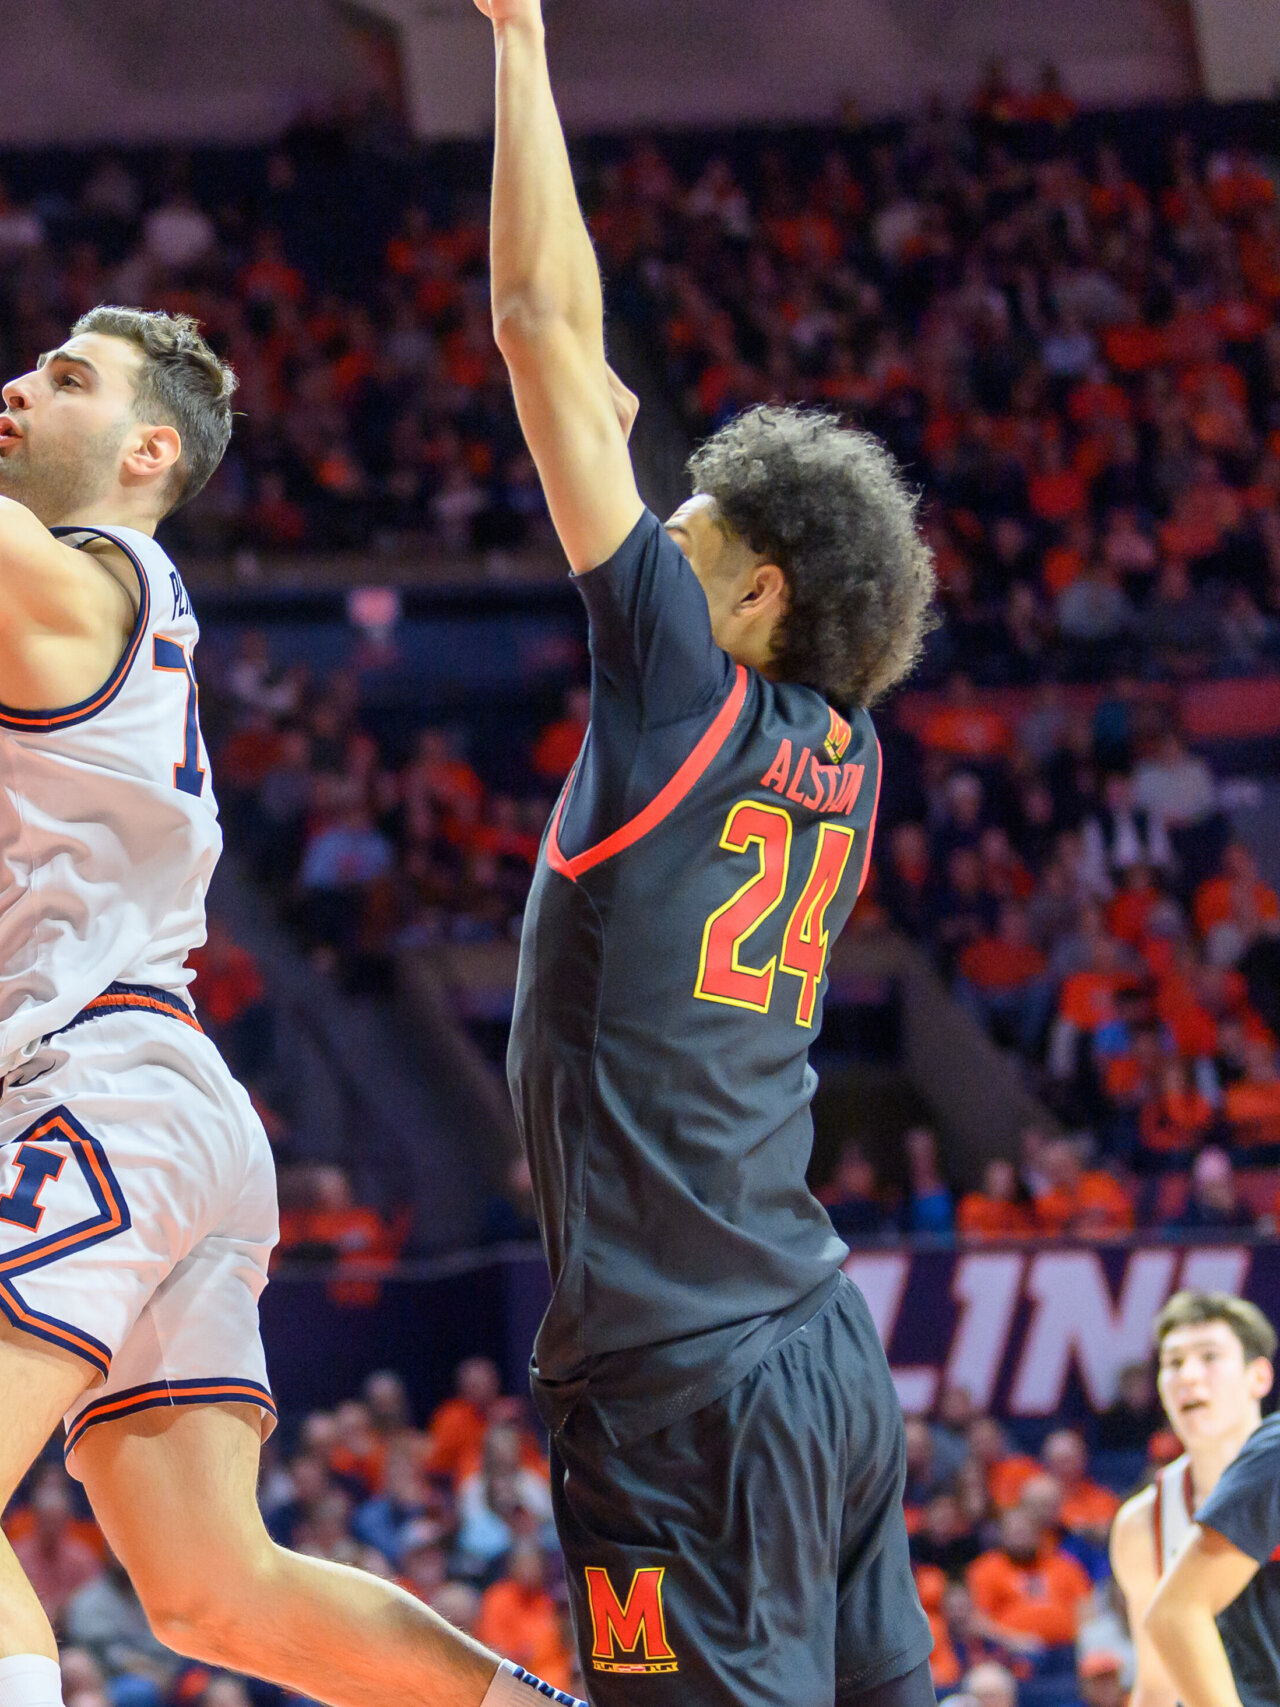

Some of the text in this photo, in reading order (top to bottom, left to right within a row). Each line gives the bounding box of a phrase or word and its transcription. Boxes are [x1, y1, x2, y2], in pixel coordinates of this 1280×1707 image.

[760, 738, 865, 816] ALSTON
[693, 799, 855, 1029] 24
[842, 1248, 1252, 1417] LIN
[584, 1566, 677, 1660] M
